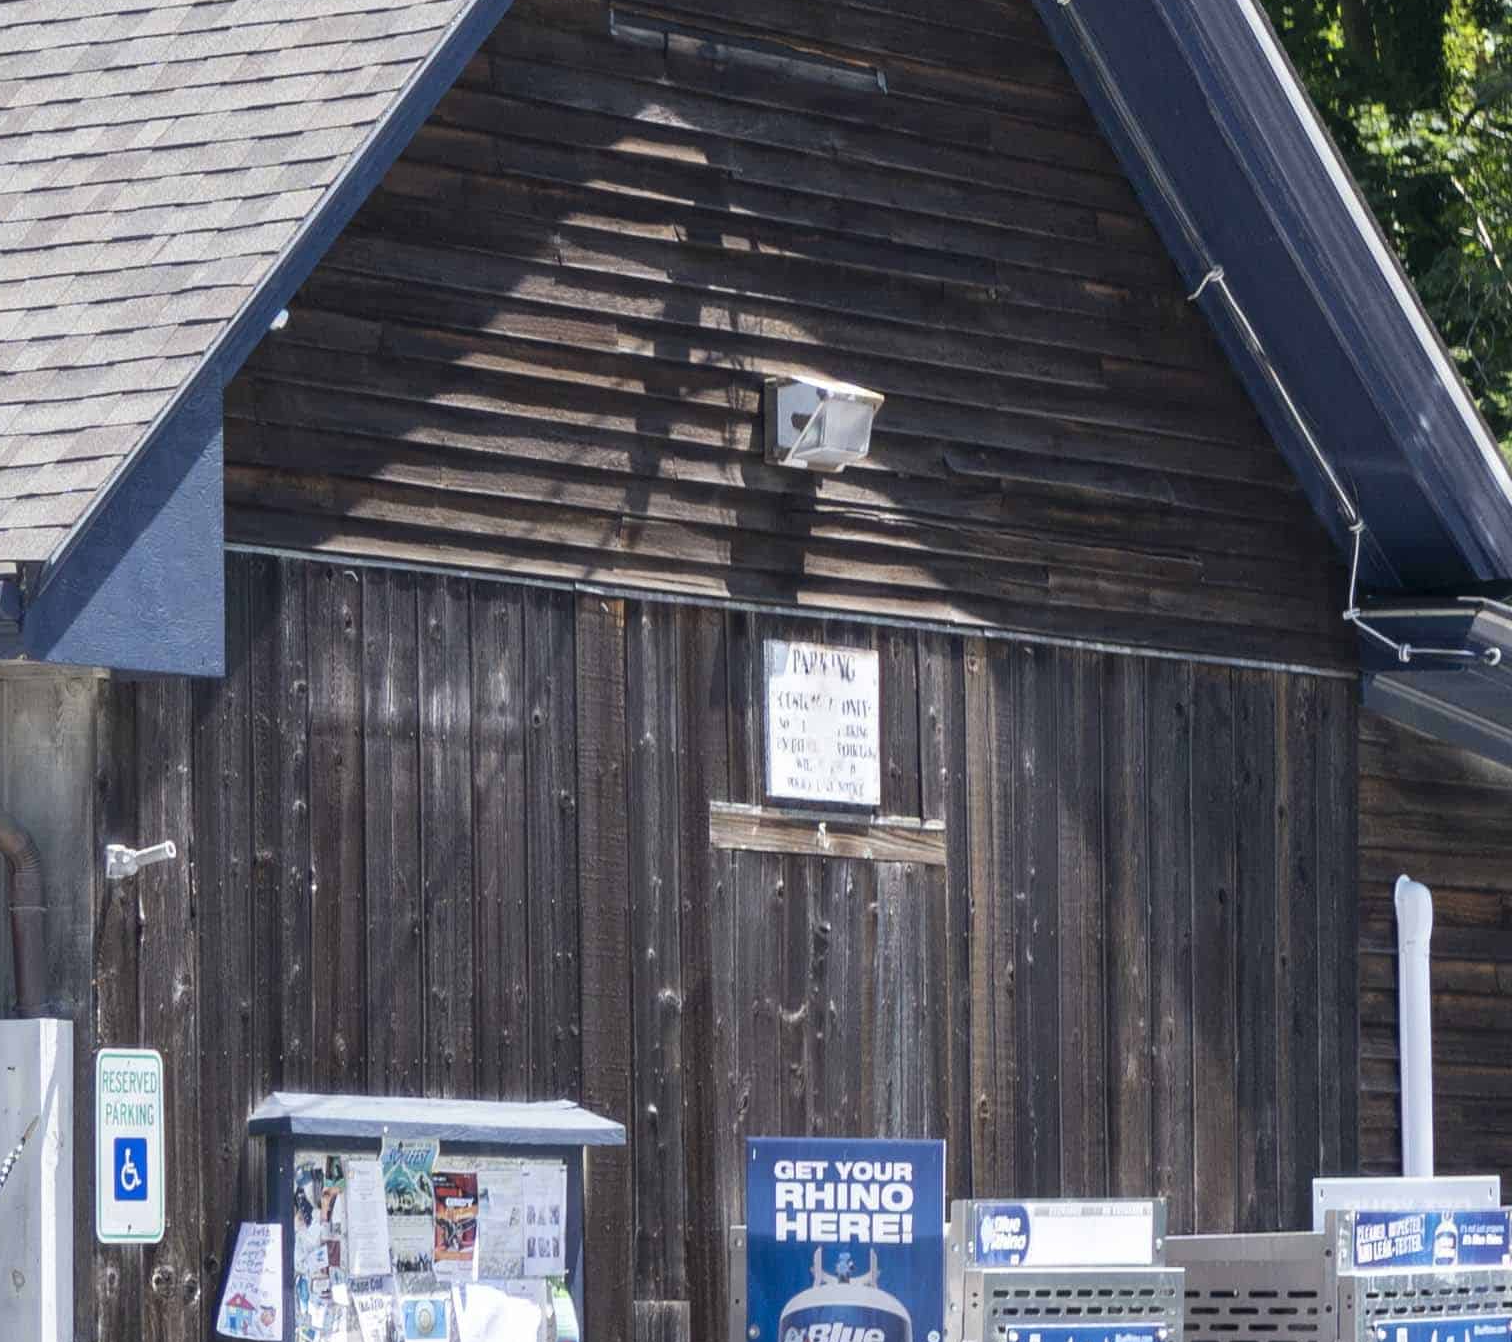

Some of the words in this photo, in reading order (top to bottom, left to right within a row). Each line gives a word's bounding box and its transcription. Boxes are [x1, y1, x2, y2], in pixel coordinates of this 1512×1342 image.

[103, 1071, 157, 1094] RESERVED
[105, 1103, 154, 1126] PARKING
[774, 1160, 828, 1179] GET
[835, 1162, 913, 1181] YOUR
[776, 1182, 913, 1212] RHINO
[776, 1212, 913, 1244] HERE!
